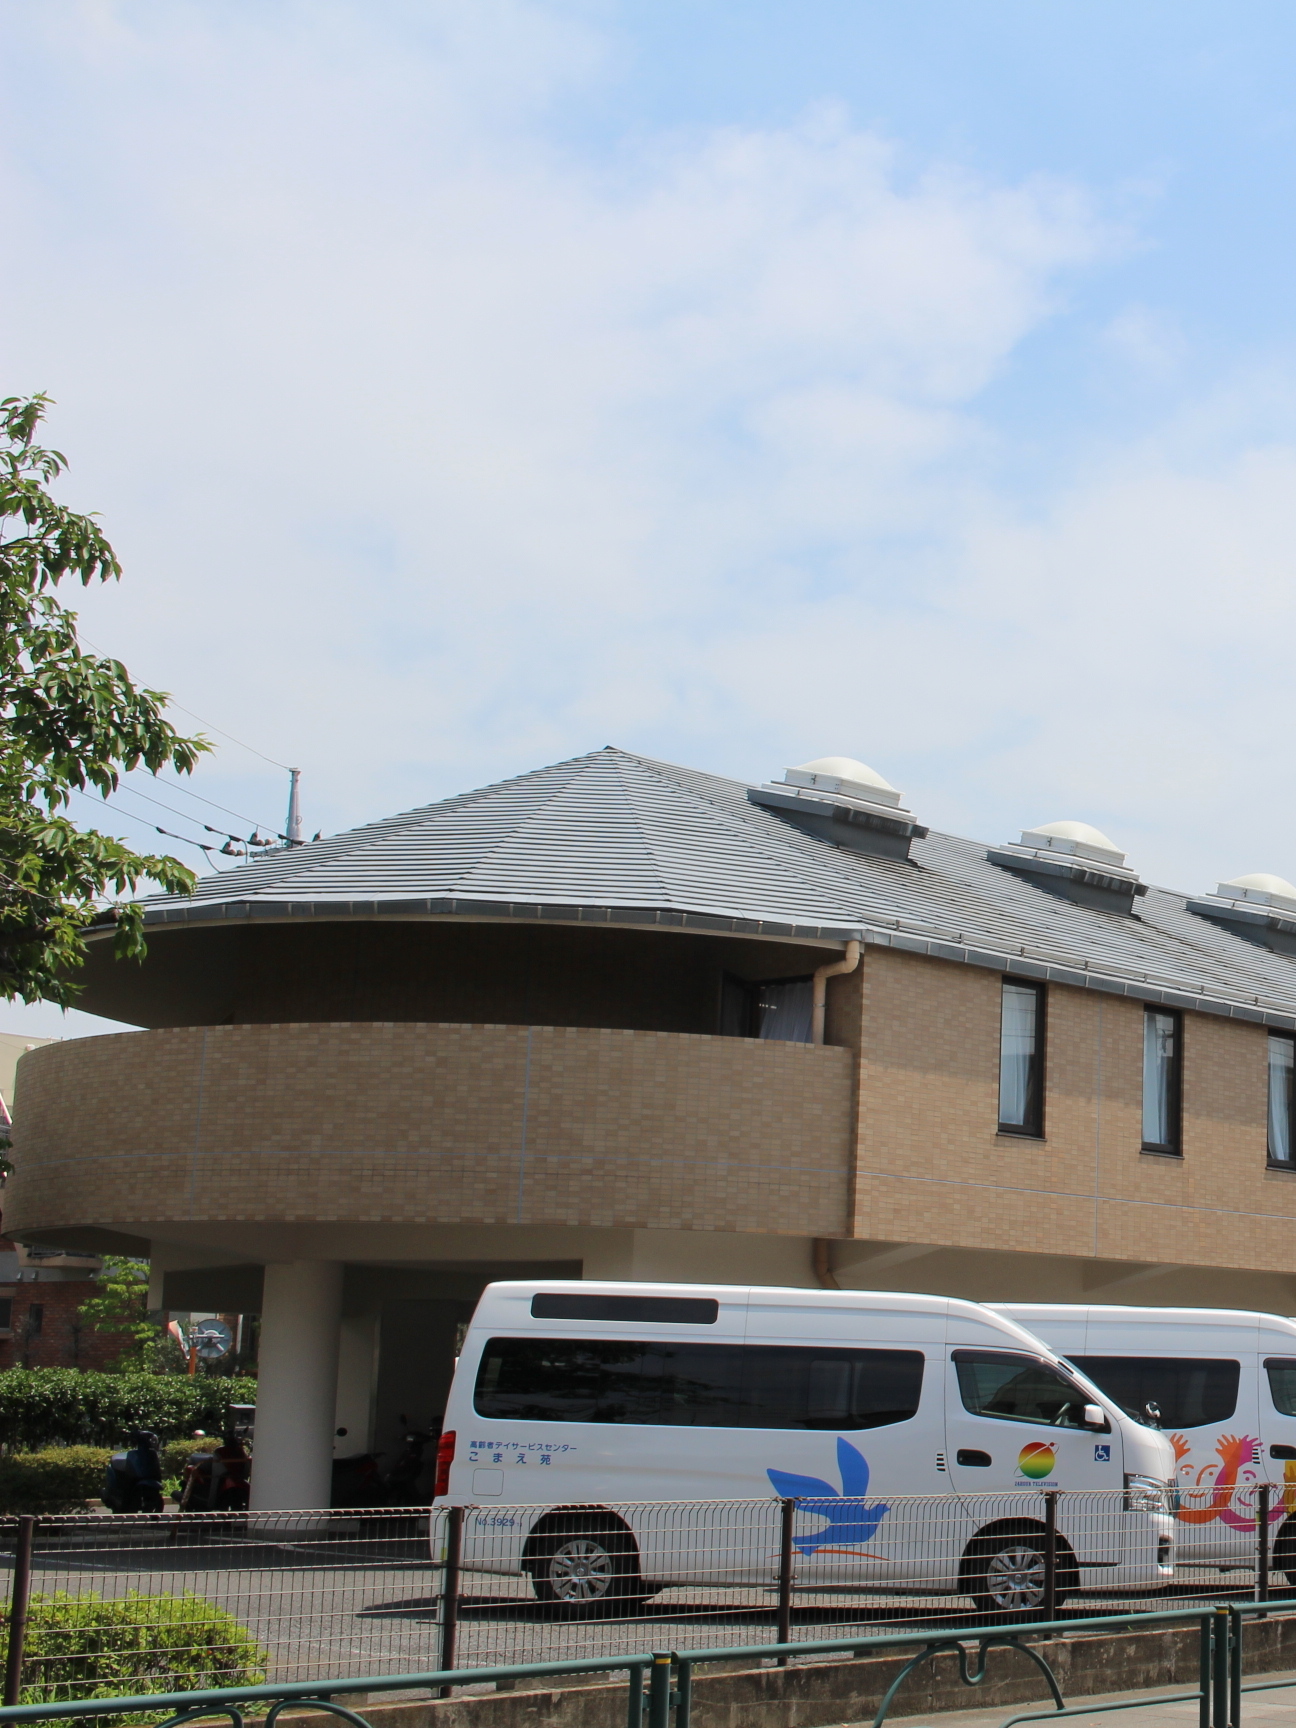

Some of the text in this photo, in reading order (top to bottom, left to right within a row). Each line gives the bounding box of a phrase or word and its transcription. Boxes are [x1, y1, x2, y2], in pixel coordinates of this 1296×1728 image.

[470, 1440, 577, 1452] 高齢者デイサービスセンター
[469, 1451, 551, 1465] こまえ苑
